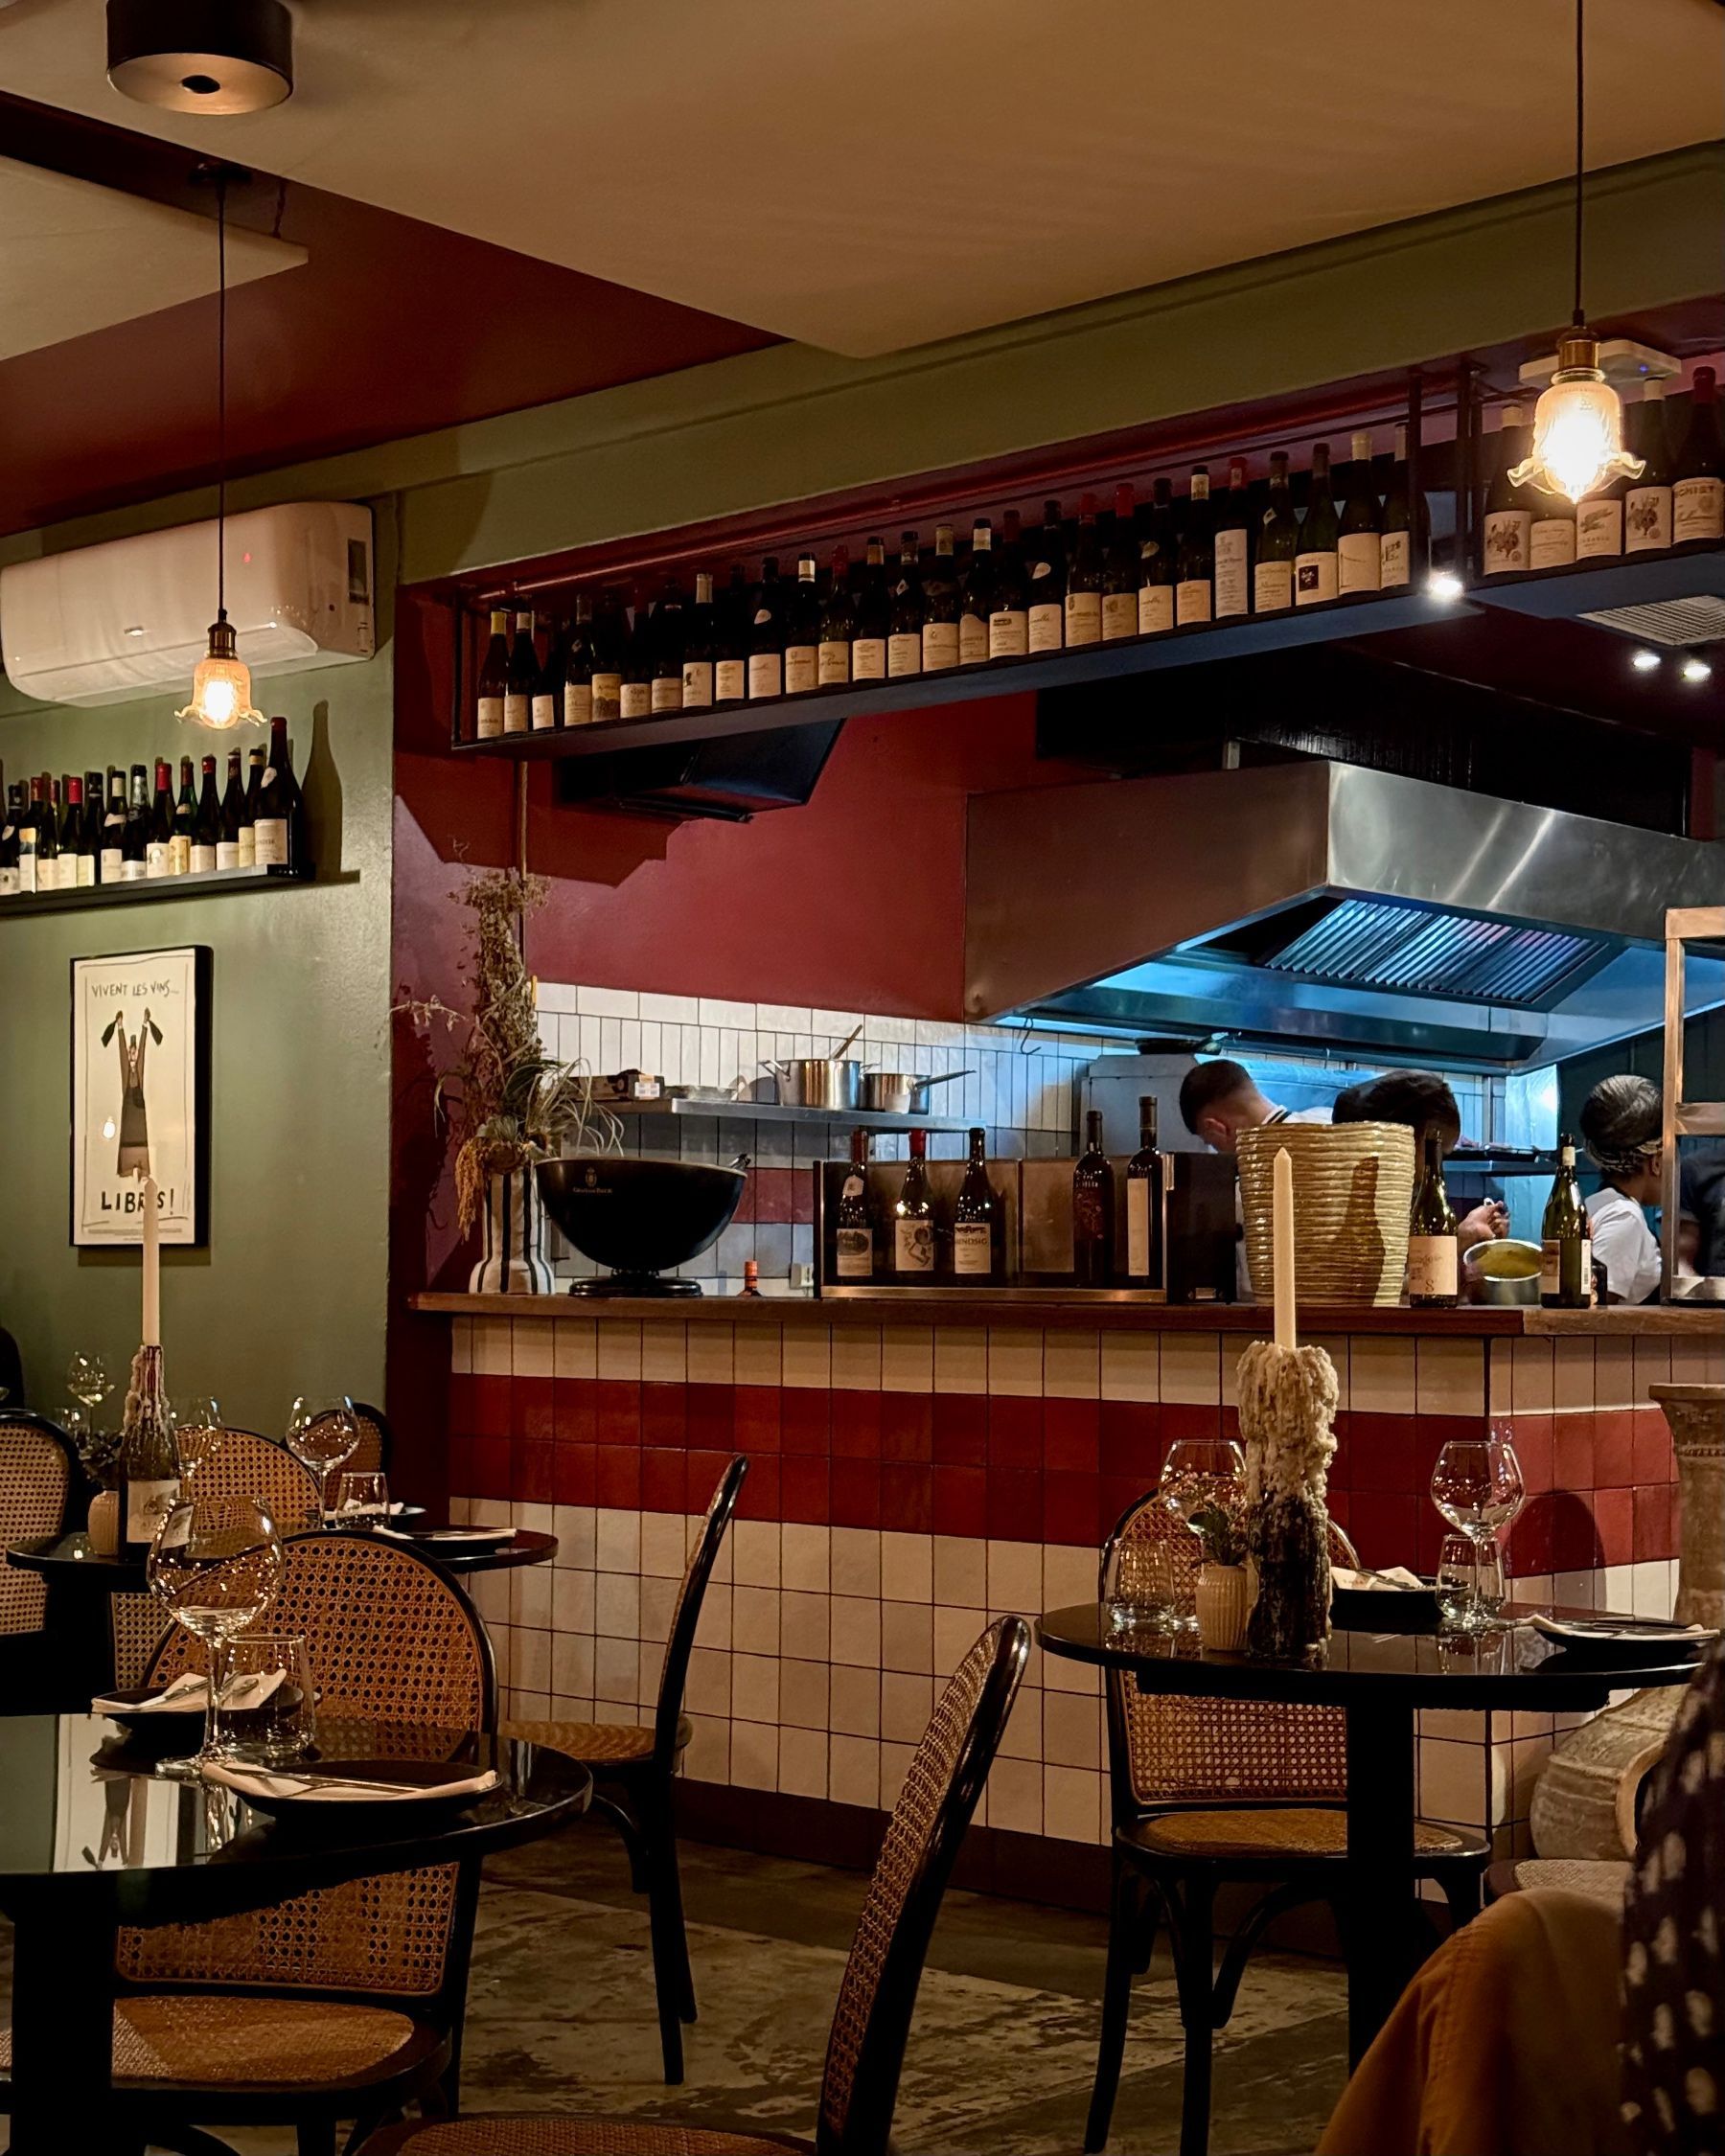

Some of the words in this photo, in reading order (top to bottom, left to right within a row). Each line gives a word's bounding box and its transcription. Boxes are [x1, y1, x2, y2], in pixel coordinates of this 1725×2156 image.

[91, 983, 127, 998] VIVENT
[132, 983, 148, 997] LES
[101, 1188, 174, 1215] LIBRS!
